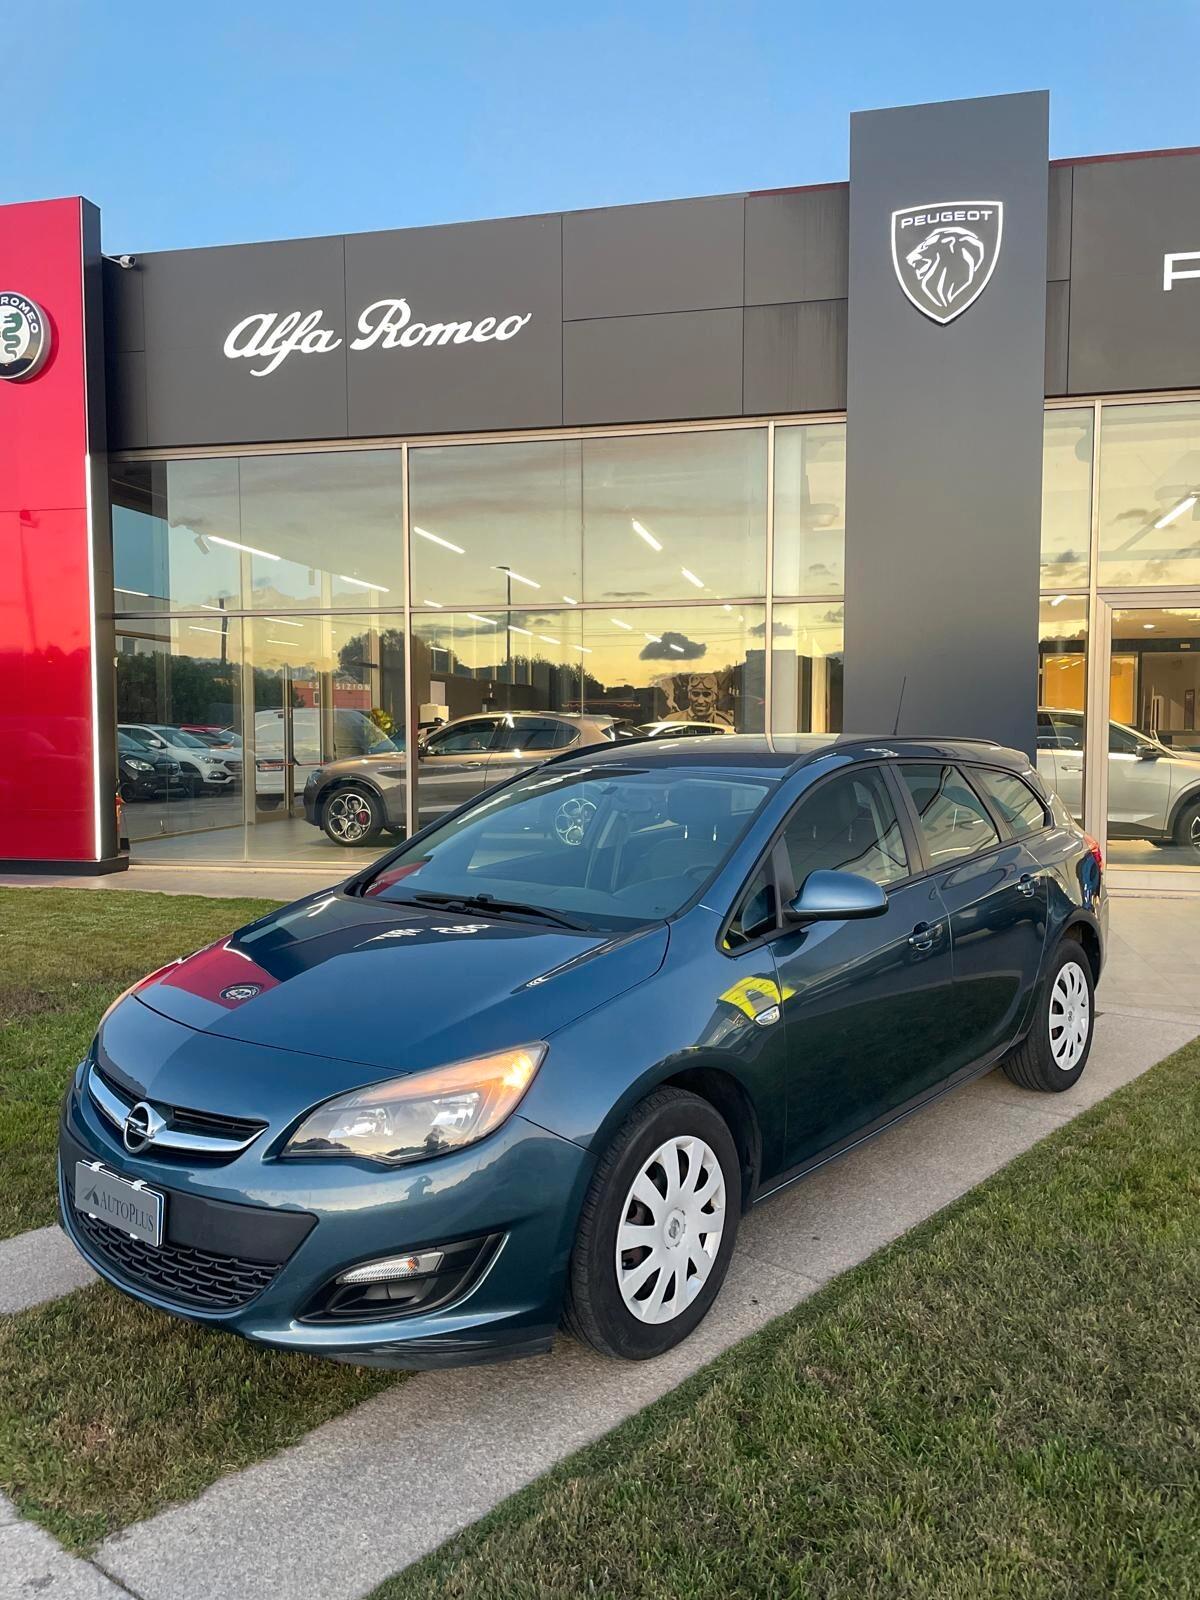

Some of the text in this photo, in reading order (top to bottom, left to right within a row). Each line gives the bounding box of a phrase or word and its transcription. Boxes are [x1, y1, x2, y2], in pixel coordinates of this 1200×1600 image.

[900, 210, 993, 229] PEUGEOT
[0, 296, 39, 334] ROMEO
[223, 297, 532, 377] Alfa Romeo
